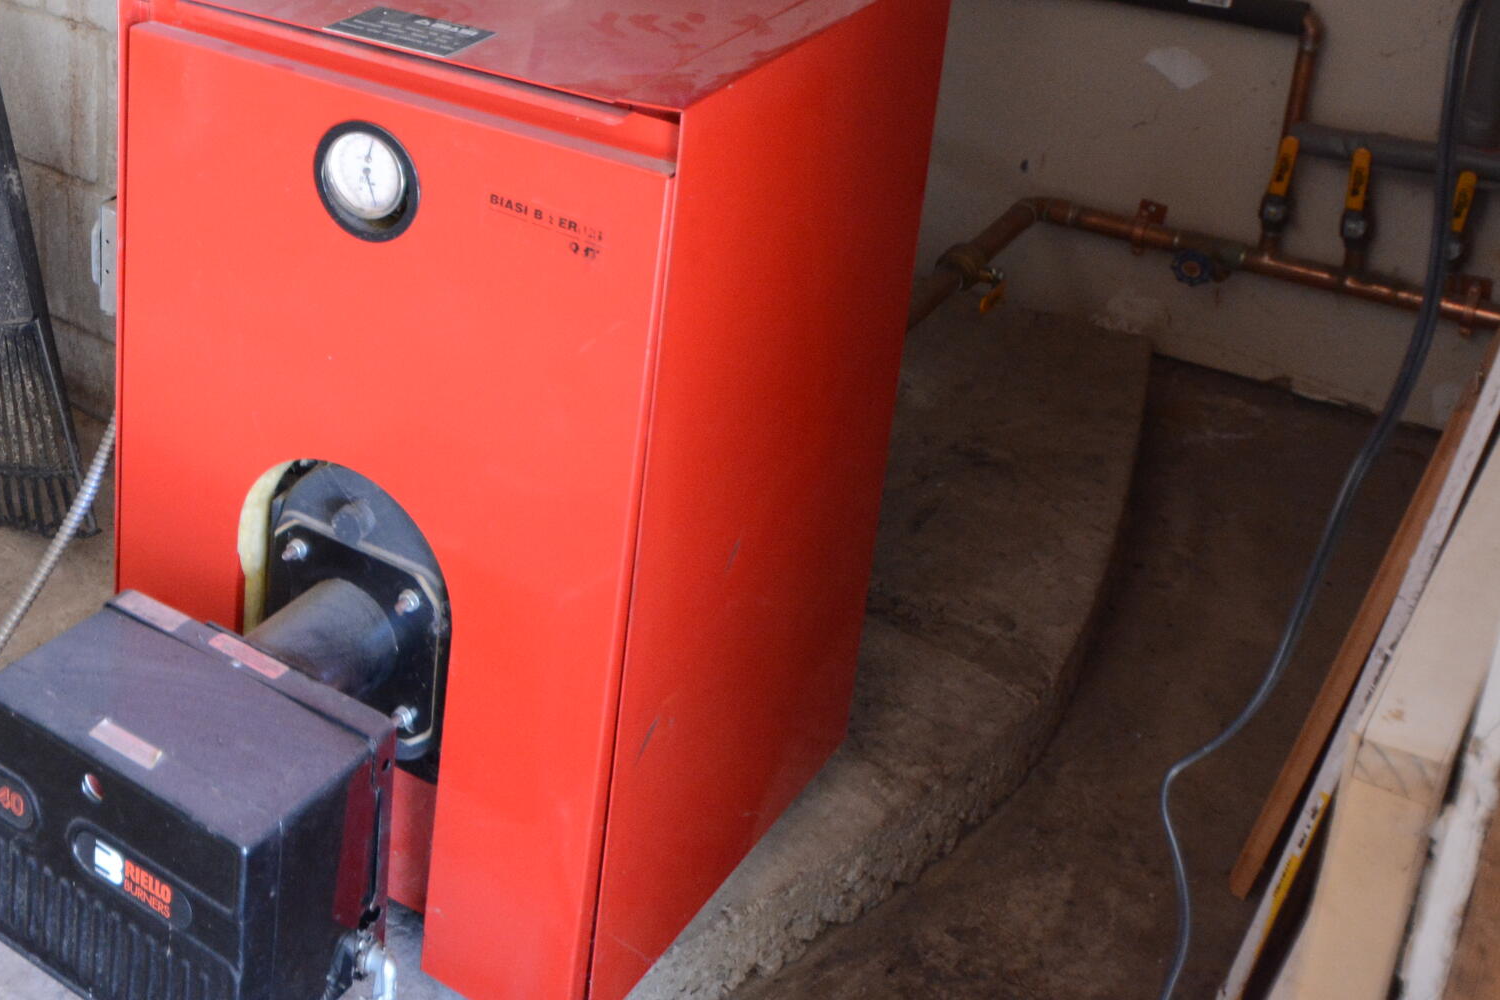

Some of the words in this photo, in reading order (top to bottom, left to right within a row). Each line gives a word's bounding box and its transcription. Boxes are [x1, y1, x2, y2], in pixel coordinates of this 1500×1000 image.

[489, 193, 528, 216] BIASI
[123, 878, 171, 919] BURNERS
[124, 859, 172, 905] RIELLO
